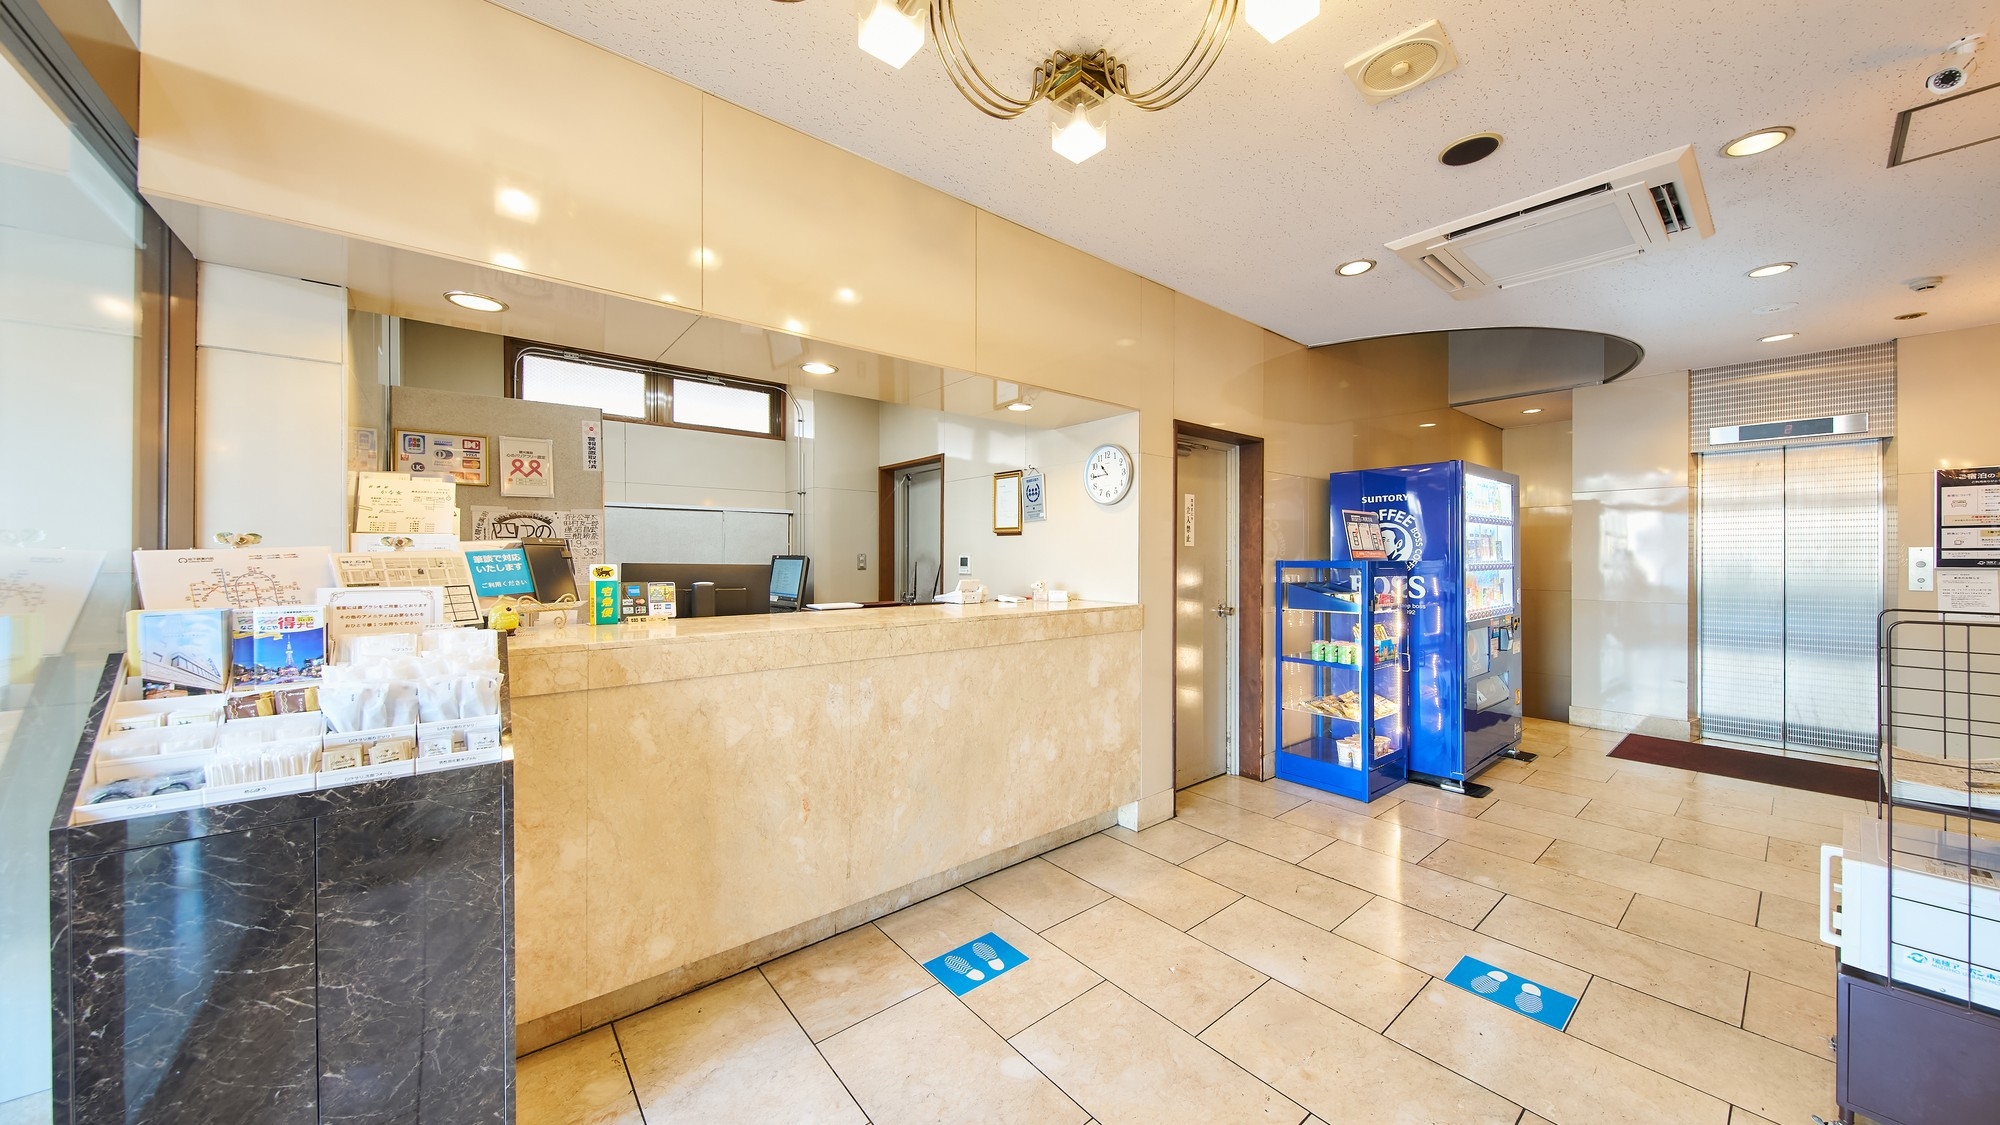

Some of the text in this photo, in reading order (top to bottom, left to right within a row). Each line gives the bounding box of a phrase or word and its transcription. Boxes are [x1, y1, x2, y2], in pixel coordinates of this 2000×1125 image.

[1378, 508, 1416, 528] FFEE
[472, 554, 522, 564] 筆談で対応
[476, 563, 523, 573] いたします
[481, 580, 527, 588] ご利用ください
[601, 586, 614, 618] 宅急便
